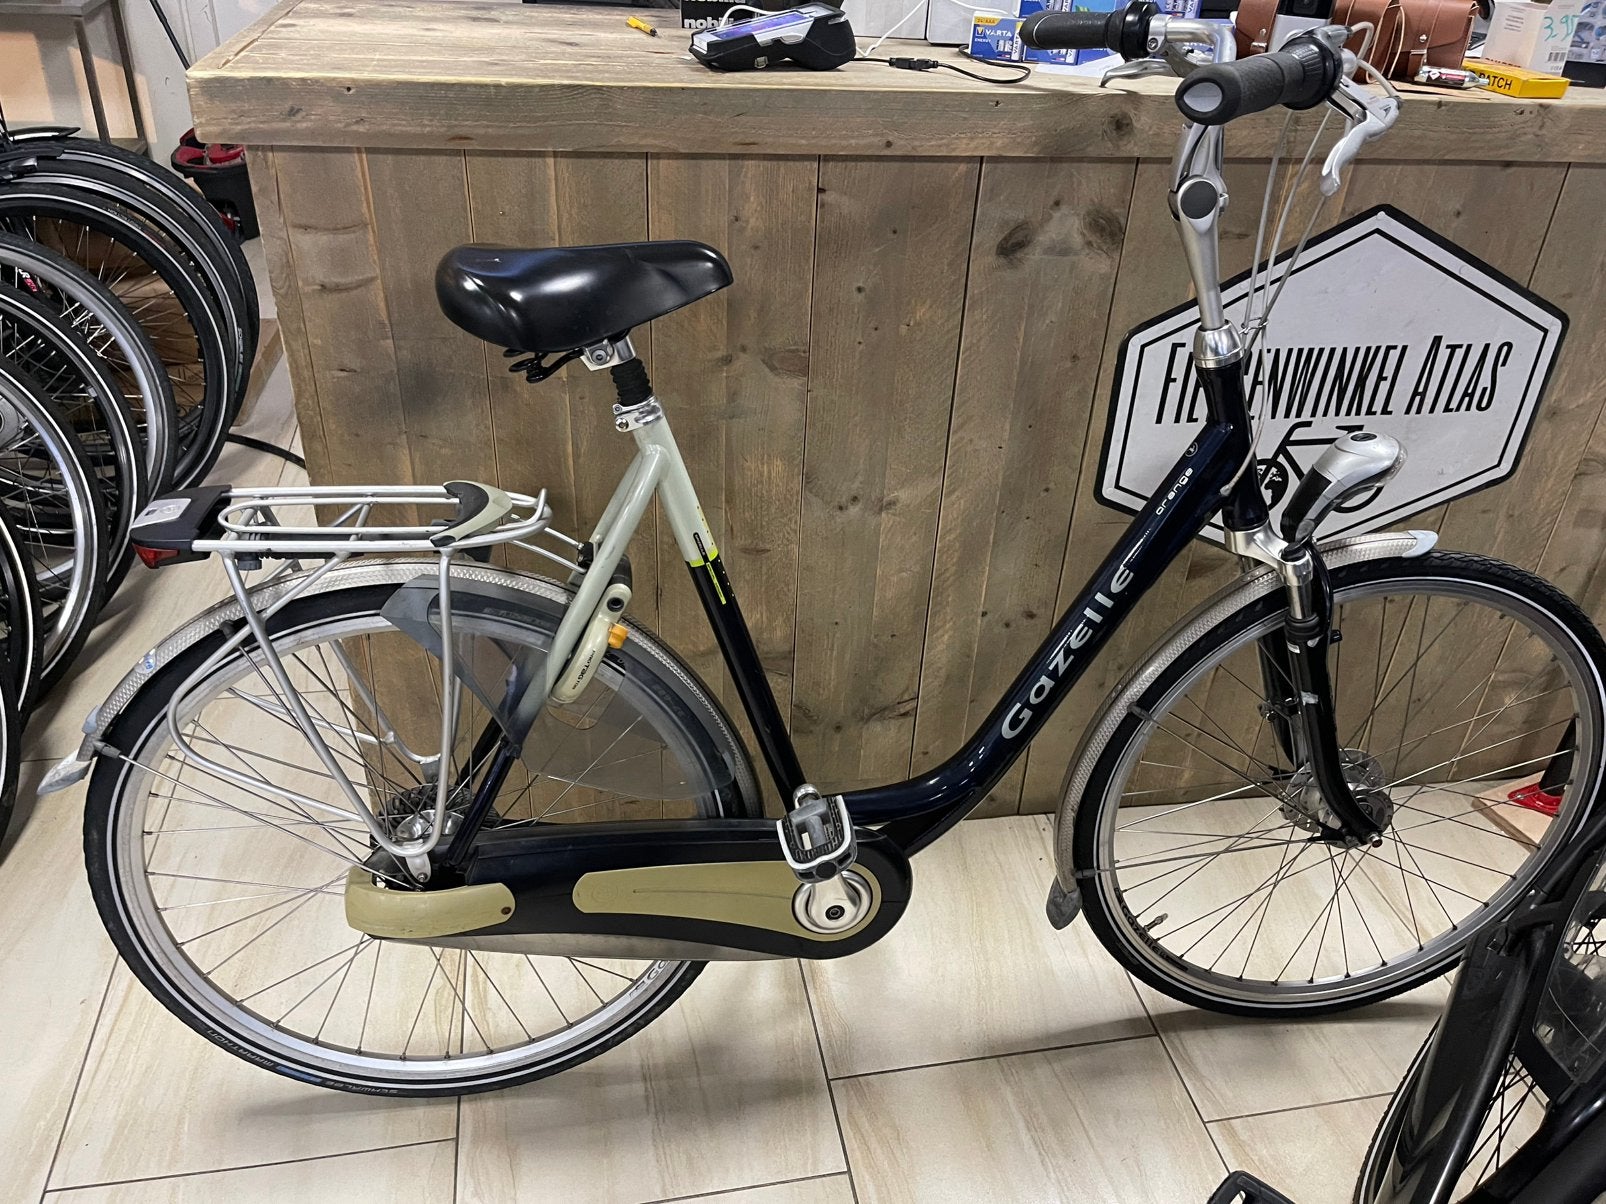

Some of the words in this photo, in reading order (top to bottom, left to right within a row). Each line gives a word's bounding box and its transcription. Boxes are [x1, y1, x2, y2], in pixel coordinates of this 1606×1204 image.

[1404, 335, 1513, 415] ATLAS
[1156, 467, 1194, 516] orange
[1001, 566, 1134, 740] Gazelle
